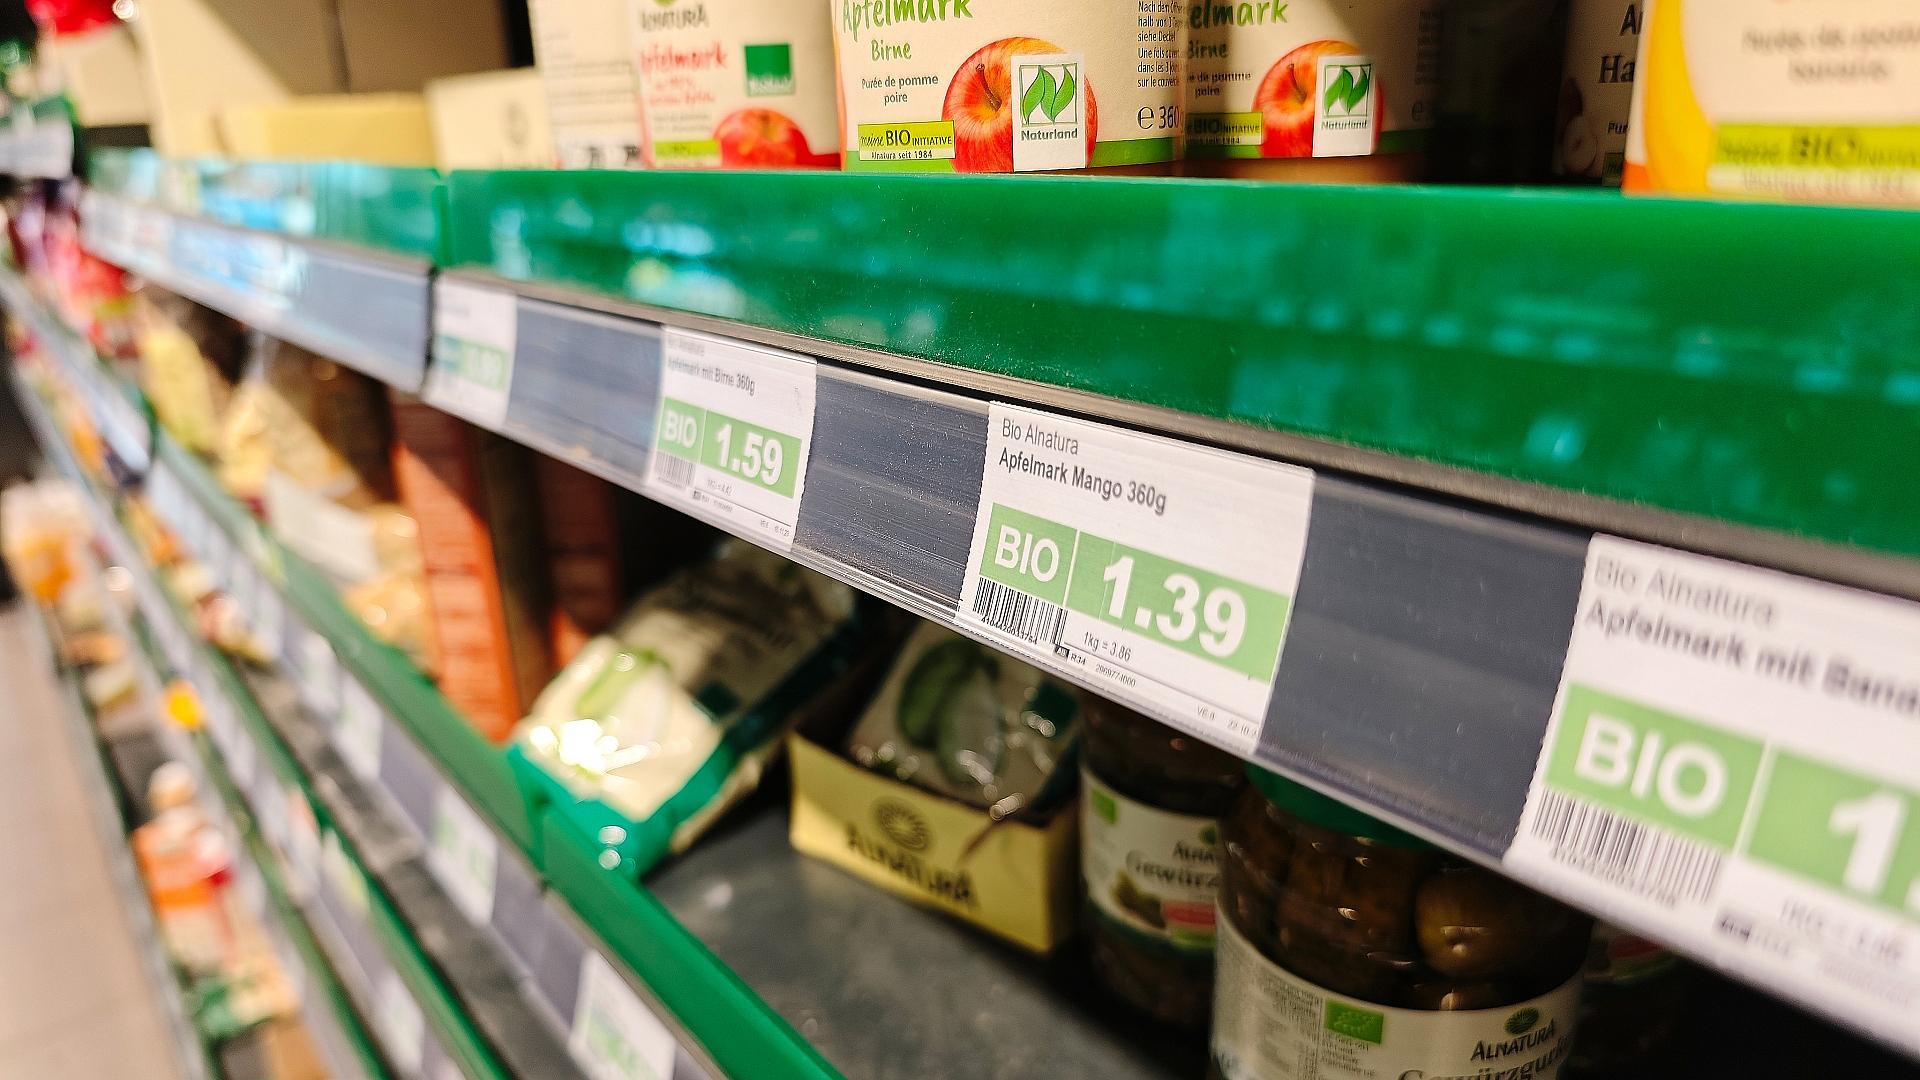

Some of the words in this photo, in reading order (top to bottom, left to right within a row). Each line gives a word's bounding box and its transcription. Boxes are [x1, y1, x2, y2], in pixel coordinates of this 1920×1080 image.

[843, 0, 973, 42] Apfelmark
[1188, 0, 1288, 28] elmark
[871, 39, 912, 61] Birne
[862, 76, 882, 89] Purée
[885, 76, 896, 87] de
[899, 76, 939, 89] pomme
[884, 92, 908, 106] poire
[886, 129, 911, 147] BIO
[912, 136, 952, 146] INITIATIVE
[1021, 128, 1078, 141] Naturland
[898, 151, 912, 159] seit
[914, 150, 933, 158] 1984
[736, 373, 756, 397] 360g
[664, 409, 698, 450] BIO
[1001, 417, 1022, 440] Bio
[1024, 428, 1079, 455] Alnatura
[715, 422, 784, 487] 1.59
[999, 447, 1068, 485] Apfelmark
[1071, 466, 1123, 503] Mango
[1126, 480, 1167, 516] 360g
[994, 524, 1061, 584] BIO
[1101, 554, 1248, 660] 1.39
[1594, 558, 1637, 594] Bio
[1645, 567, 1775, 625] Alnatura
[1084, 631, 1100, 653] 1kg
[1110, 641, 1132, 662] 3.86
[1585, 602, 1745, 666] Apfelmark
[1756, 644, 1816, 684] mit
[1575, 714, 1726, 816] BIO
[1470, 1018, 1555, 1062] ALNATURA
